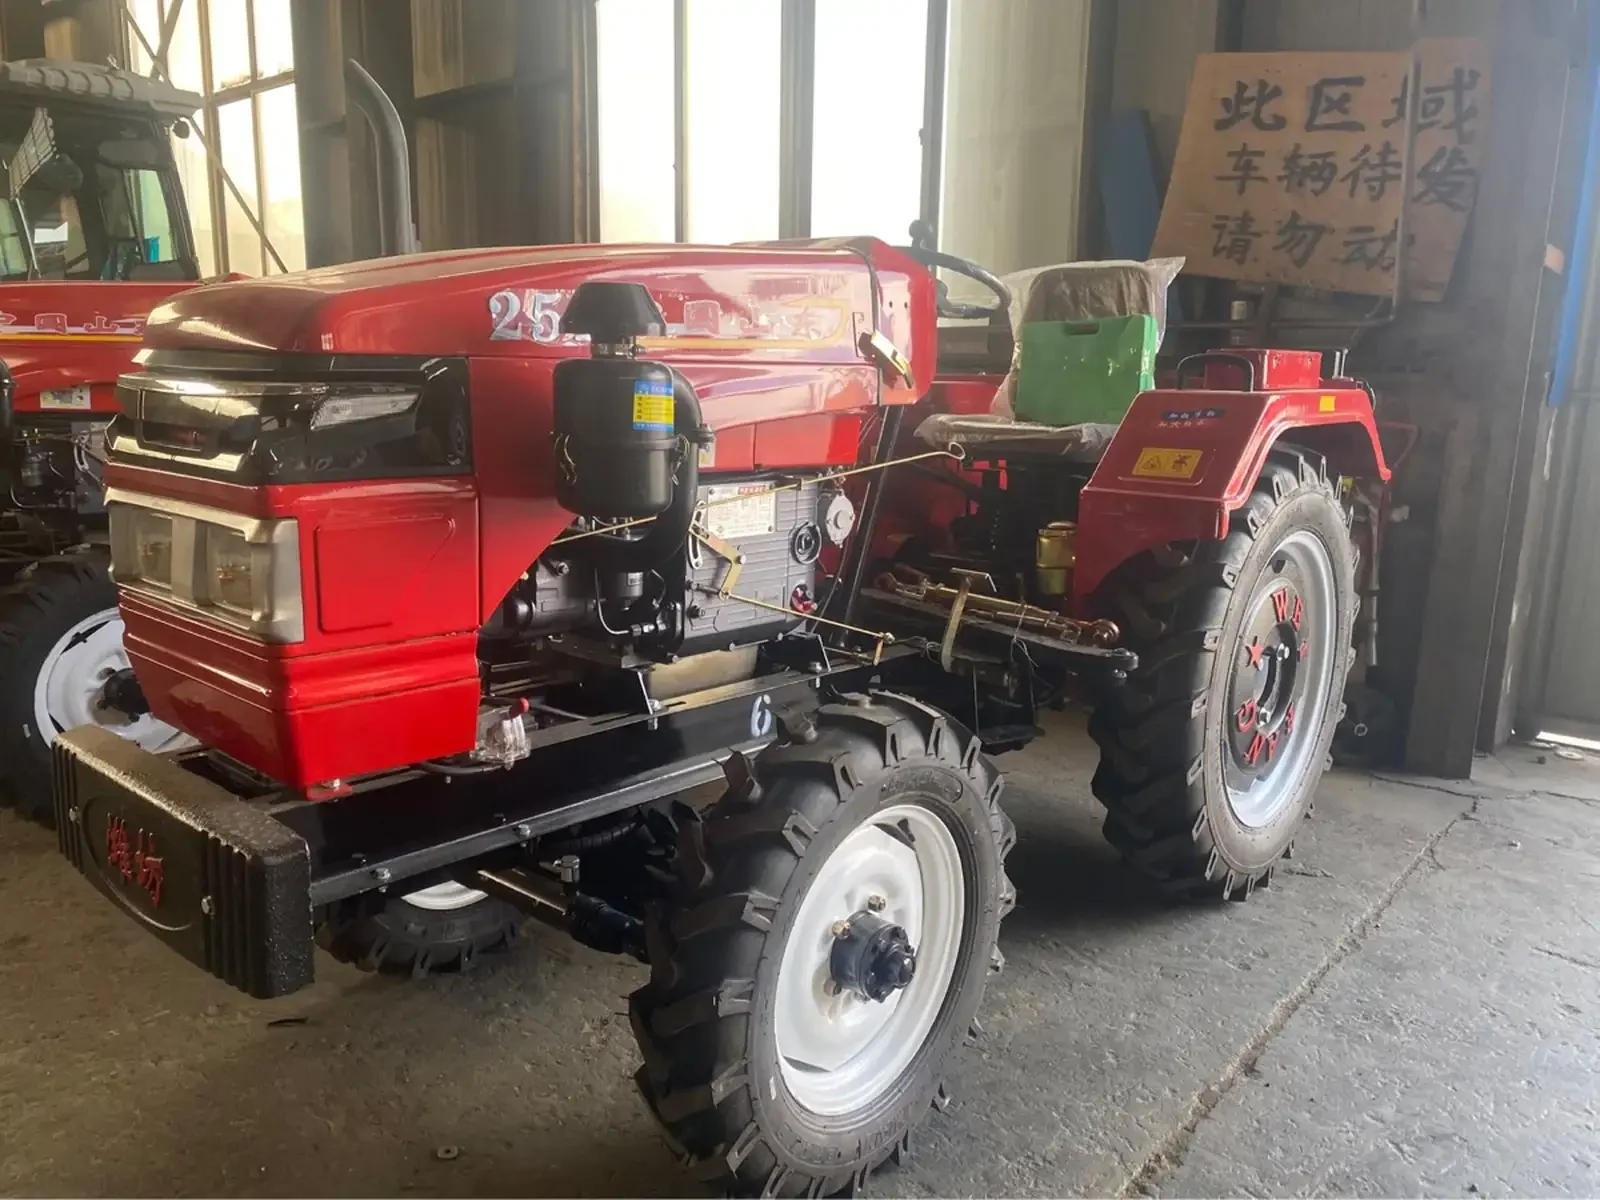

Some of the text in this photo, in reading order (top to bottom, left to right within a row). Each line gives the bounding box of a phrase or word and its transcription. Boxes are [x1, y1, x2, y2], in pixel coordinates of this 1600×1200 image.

[1214, 67, 1482, 145] 此区域
[1214, 141, 1480, 212] 车辆待发
[1211, 209, 1416, 272] 请勿动
[488, 291, 592, 342] 25
[750, 693, 772, 737] 6
